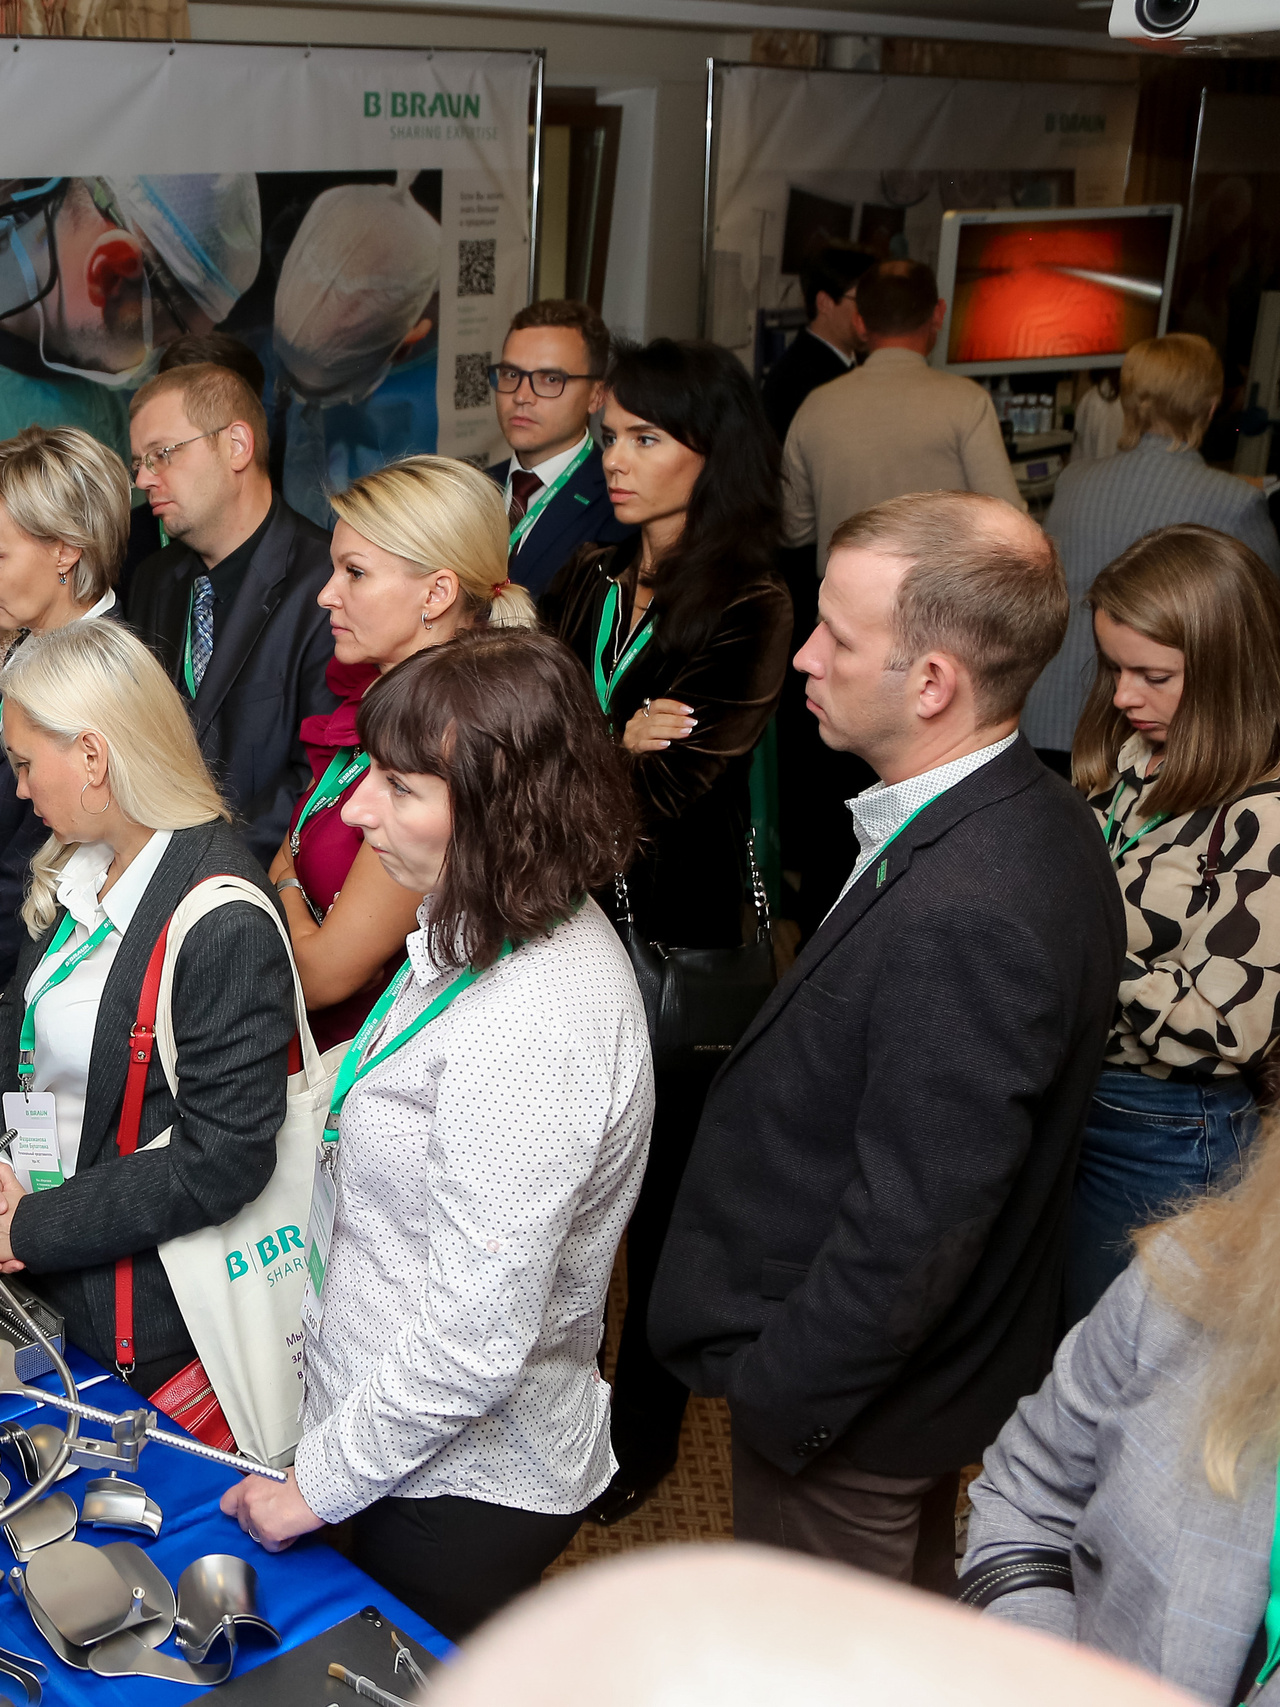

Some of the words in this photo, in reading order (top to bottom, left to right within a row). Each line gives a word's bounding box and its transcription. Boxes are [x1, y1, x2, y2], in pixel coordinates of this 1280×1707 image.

[363, 91, 381, 118] B
[390, 91, 481, 118] BRAUN
[390, 124, 441, 140] SHARING
[356, 1023, 374, 1051] BRAUN
[224, 1248, 250, 1283] B
[286, 1331, 304, 1348] Мы
